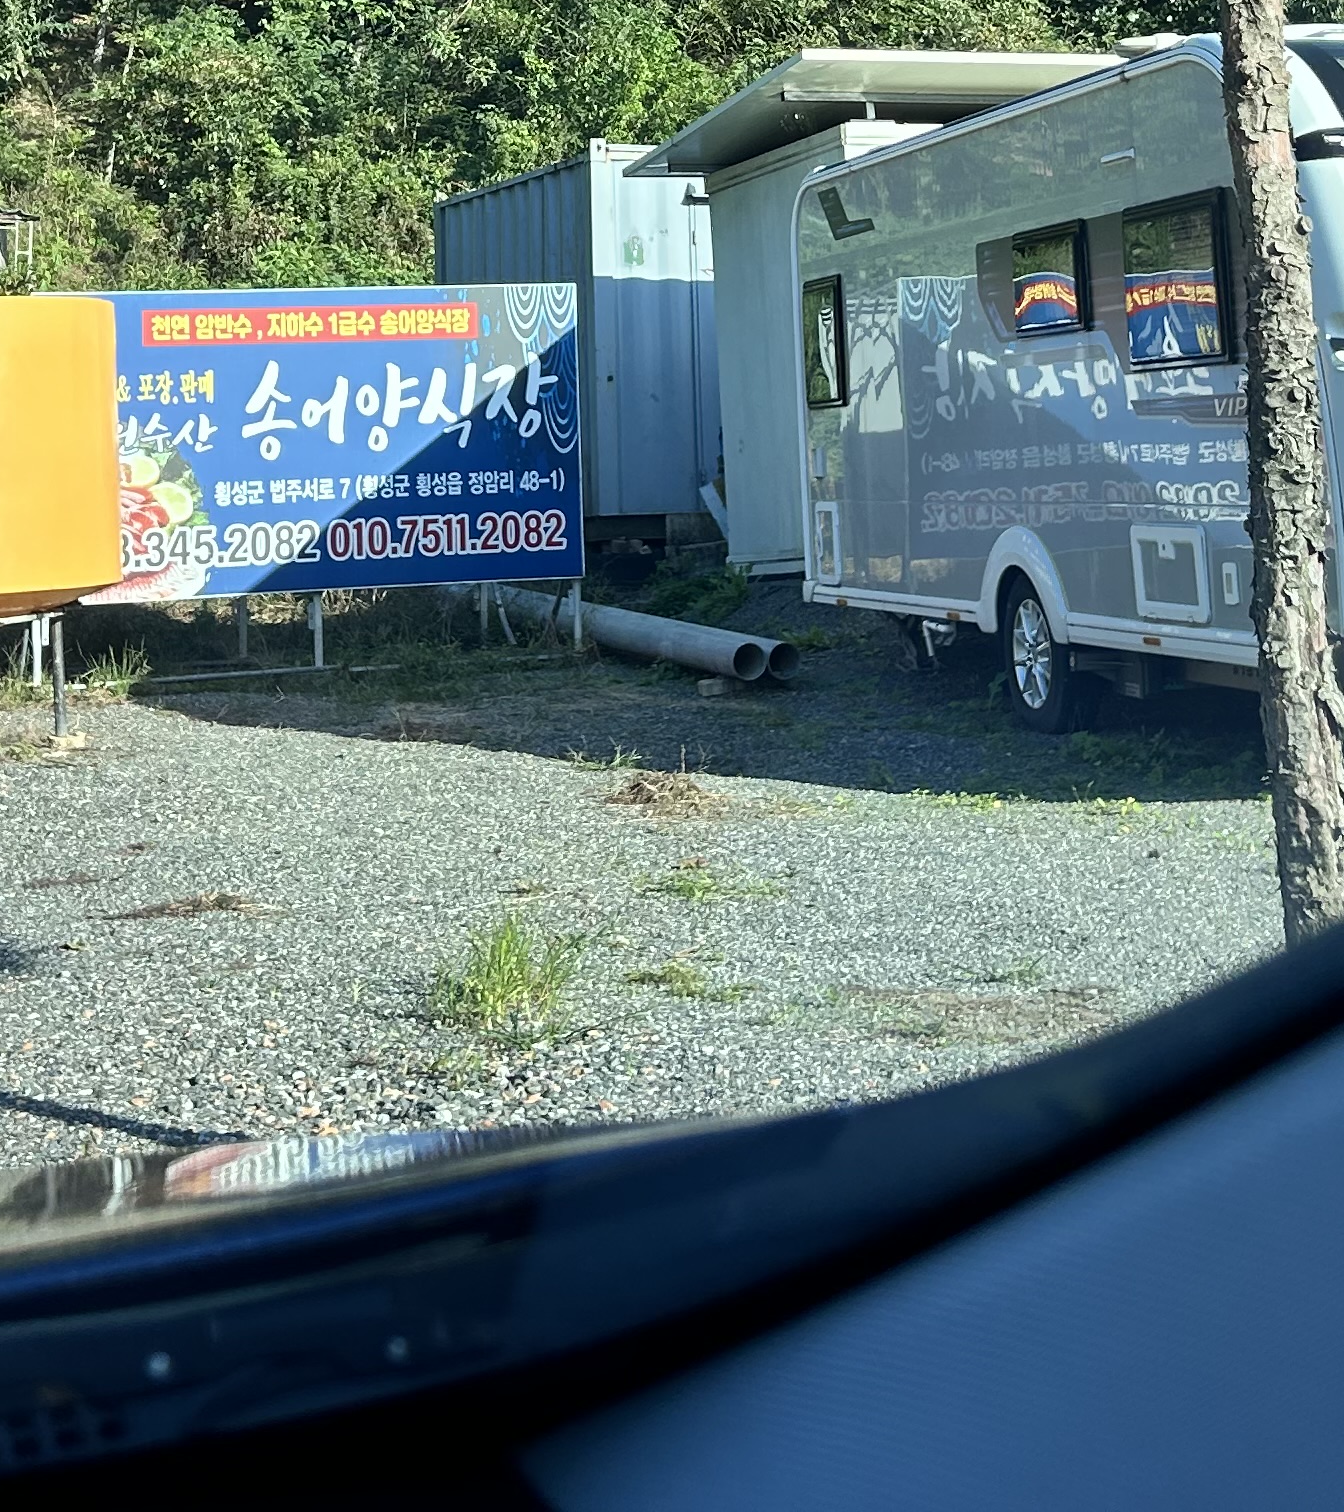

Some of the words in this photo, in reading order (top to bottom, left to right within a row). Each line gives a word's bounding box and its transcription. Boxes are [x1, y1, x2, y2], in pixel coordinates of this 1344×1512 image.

[150, 313, 191, 342] 천연
[266, 311, 324, 338] 지하수
[328, 310, 376, 336] 1급수
[380, 308, 471, 336] 송어양식장
[241, 352, 559, 461] 송어양식장
[1214, 397, 1248, 417] VIP
[214, 480, 265, 507] 횡성군
[269, 477, 336, 504] 법주서로
[339, 477, 351, 499] 7
[355, 474, 411, 501] (횡성군
[415, 471, 464, 497] 횡성읍
[468, 469, 514, 495] 정암리
[519, 467, 565, 492] 48-1)
[327, 509, 568, 561] 010.7511.2082
